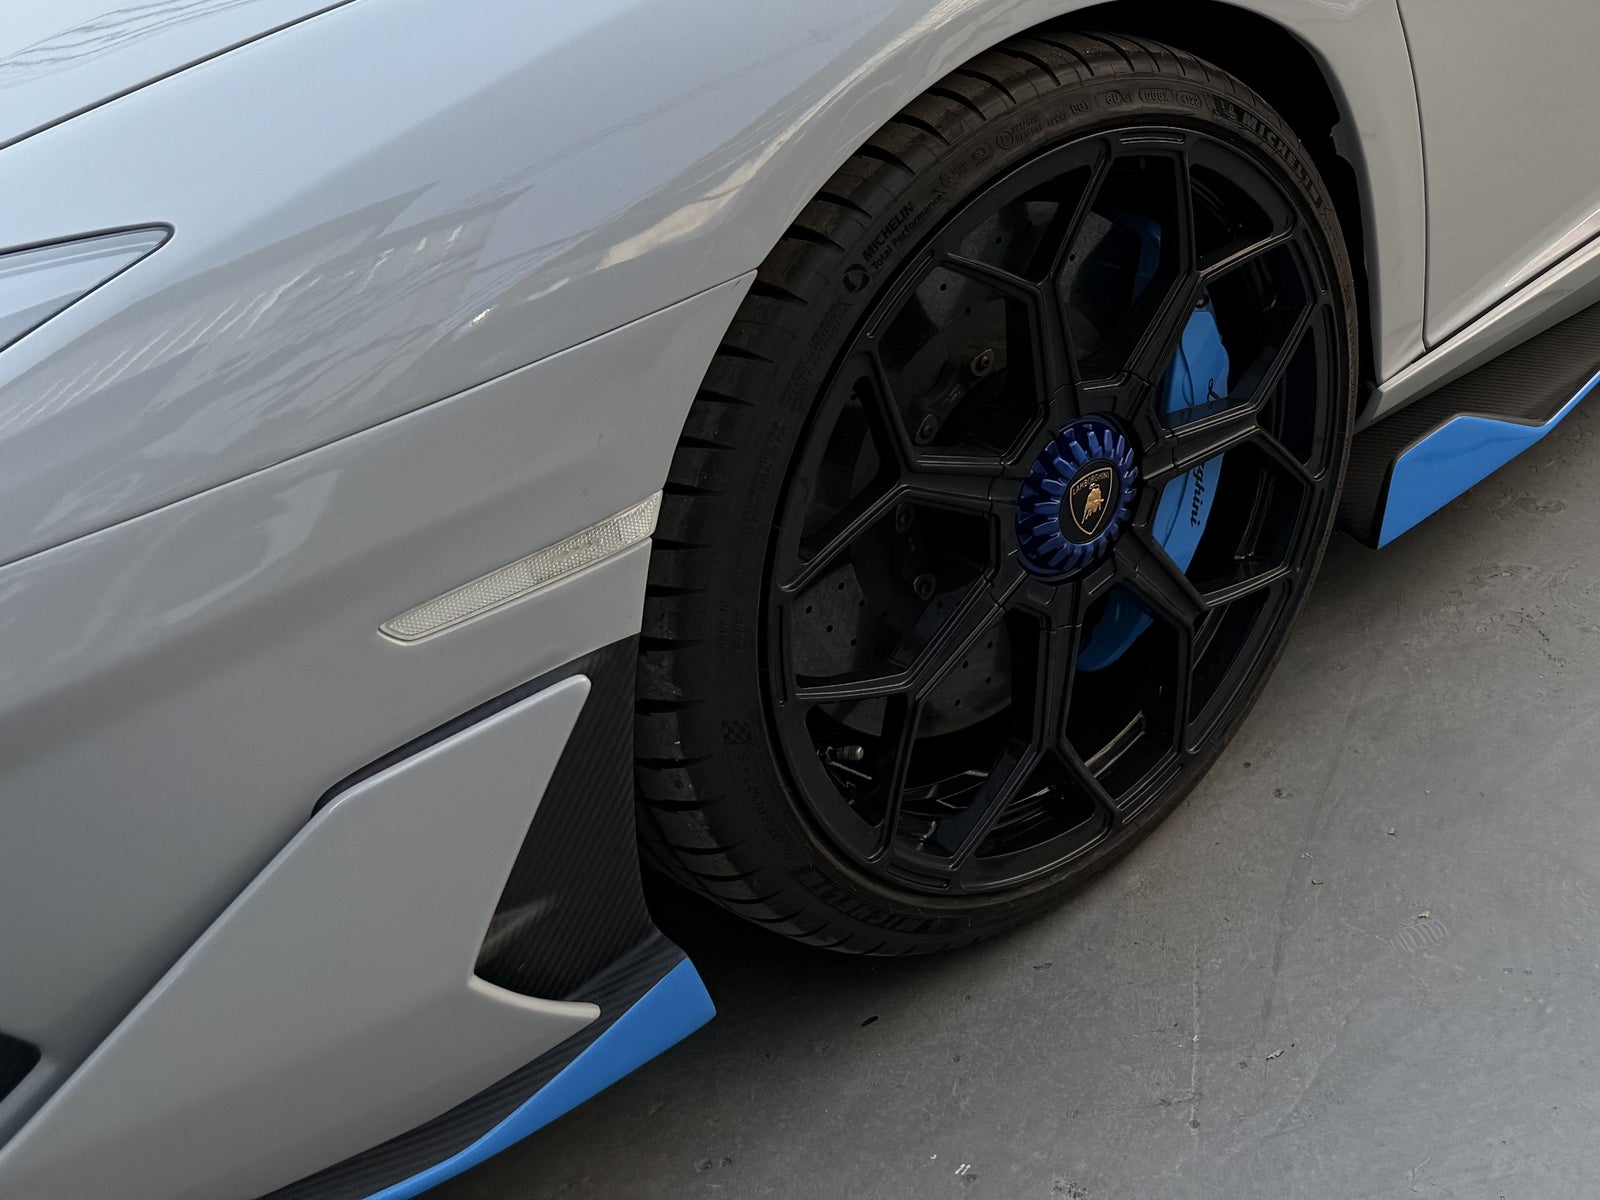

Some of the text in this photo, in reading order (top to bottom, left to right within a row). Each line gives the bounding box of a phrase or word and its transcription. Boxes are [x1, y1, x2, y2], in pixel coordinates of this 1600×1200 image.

[1241, 111, 1323, 209] MICHELIN
[862, 200, 914, 262] MICHELIN
[871, 243, 893, 271] Total
[1072, 470, 1110, 495] LAMBORGHINI
